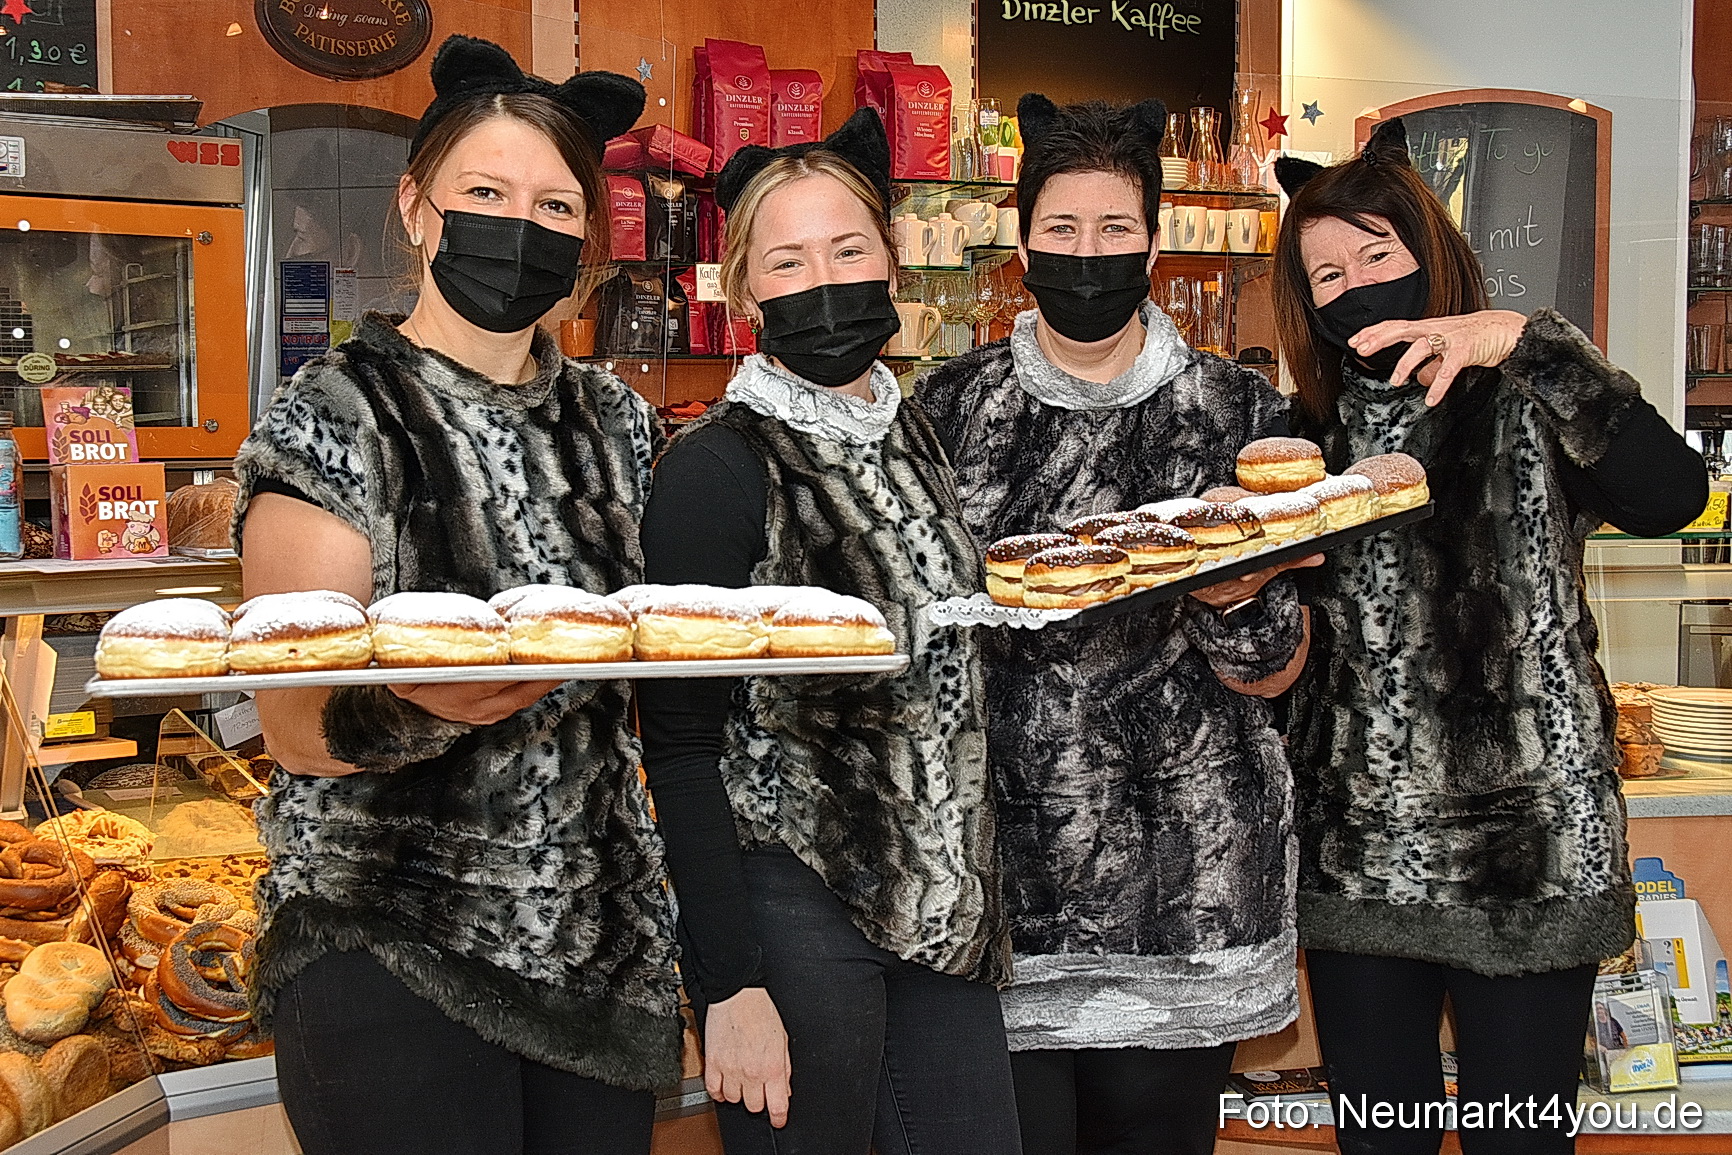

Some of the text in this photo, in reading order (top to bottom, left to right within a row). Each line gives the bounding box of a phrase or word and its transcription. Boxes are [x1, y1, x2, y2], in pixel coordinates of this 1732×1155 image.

[1001, 0, 1202, 41] Dinzler Kaffee
[293, 22, 398, 58] PATISSERIE
[6, 36, 89, 66] 1,30 €
[725, 94, 763, 104] DINZLER
[907, 101, 944, 111] DINZLER
[777, 103, 815, 112] DINZLER
[1480, 128, 1511, 161] To
[1514, 143, 1554, 175] go
[1489, 205, 1543, 252] mit
[282, 334, 328, 345] NOTRUF
[23, 363, 51, 371] DÜRING
[69, 430, 112, 443] SOLI
[70, 443, 128, 460] BROT
[98, 485, 142, 501] SOLI
[98, 500, 159, 520] BROT
